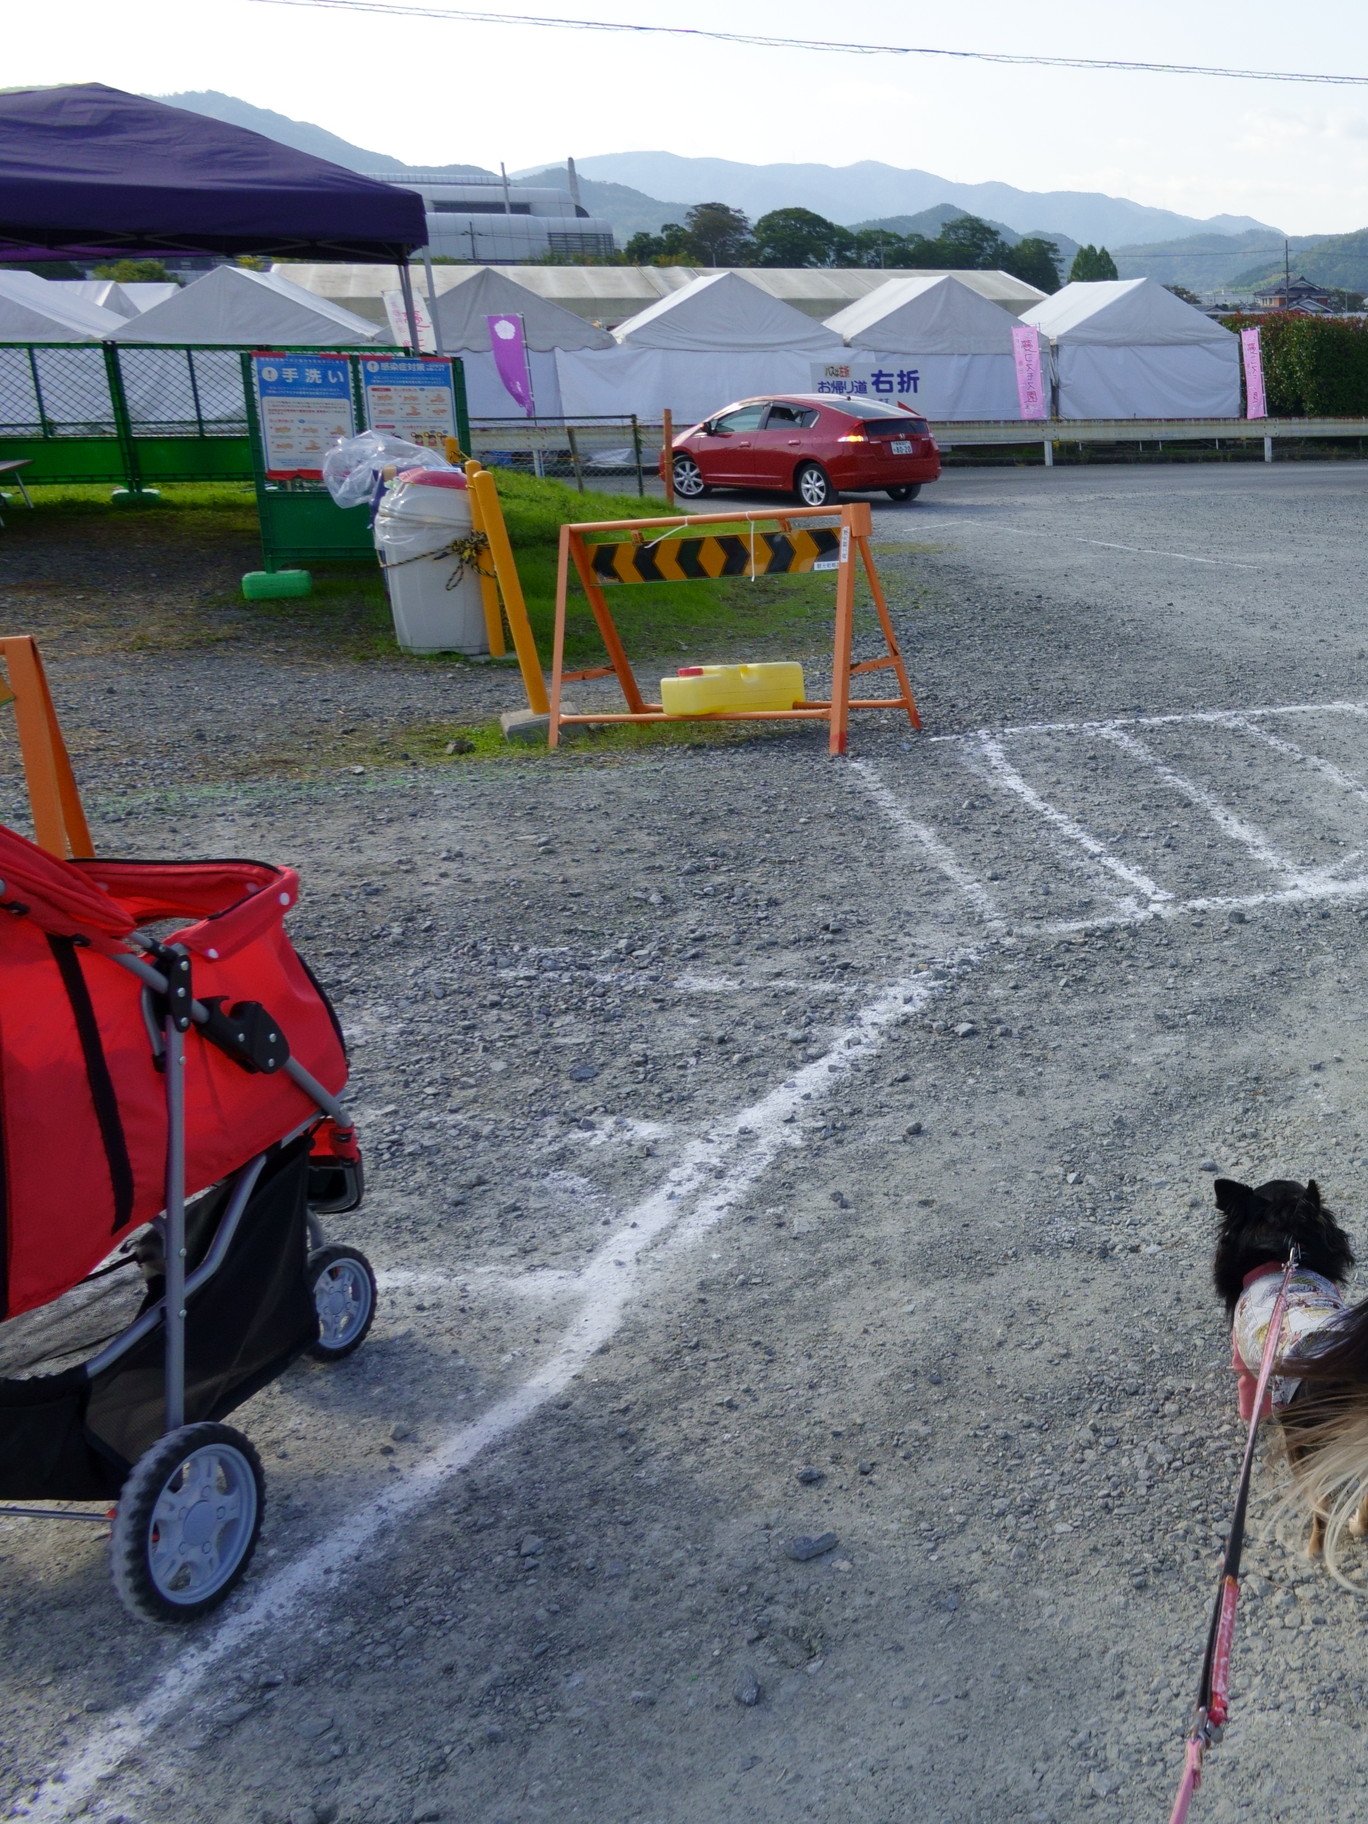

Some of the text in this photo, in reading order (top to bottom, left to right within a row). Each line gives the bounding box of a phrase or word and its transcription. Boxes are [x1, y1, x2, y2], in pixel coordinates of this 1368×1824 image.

[281, 367, 344, 384] 手洗い
[817, 369, 920, 394] お帰り道 右折
